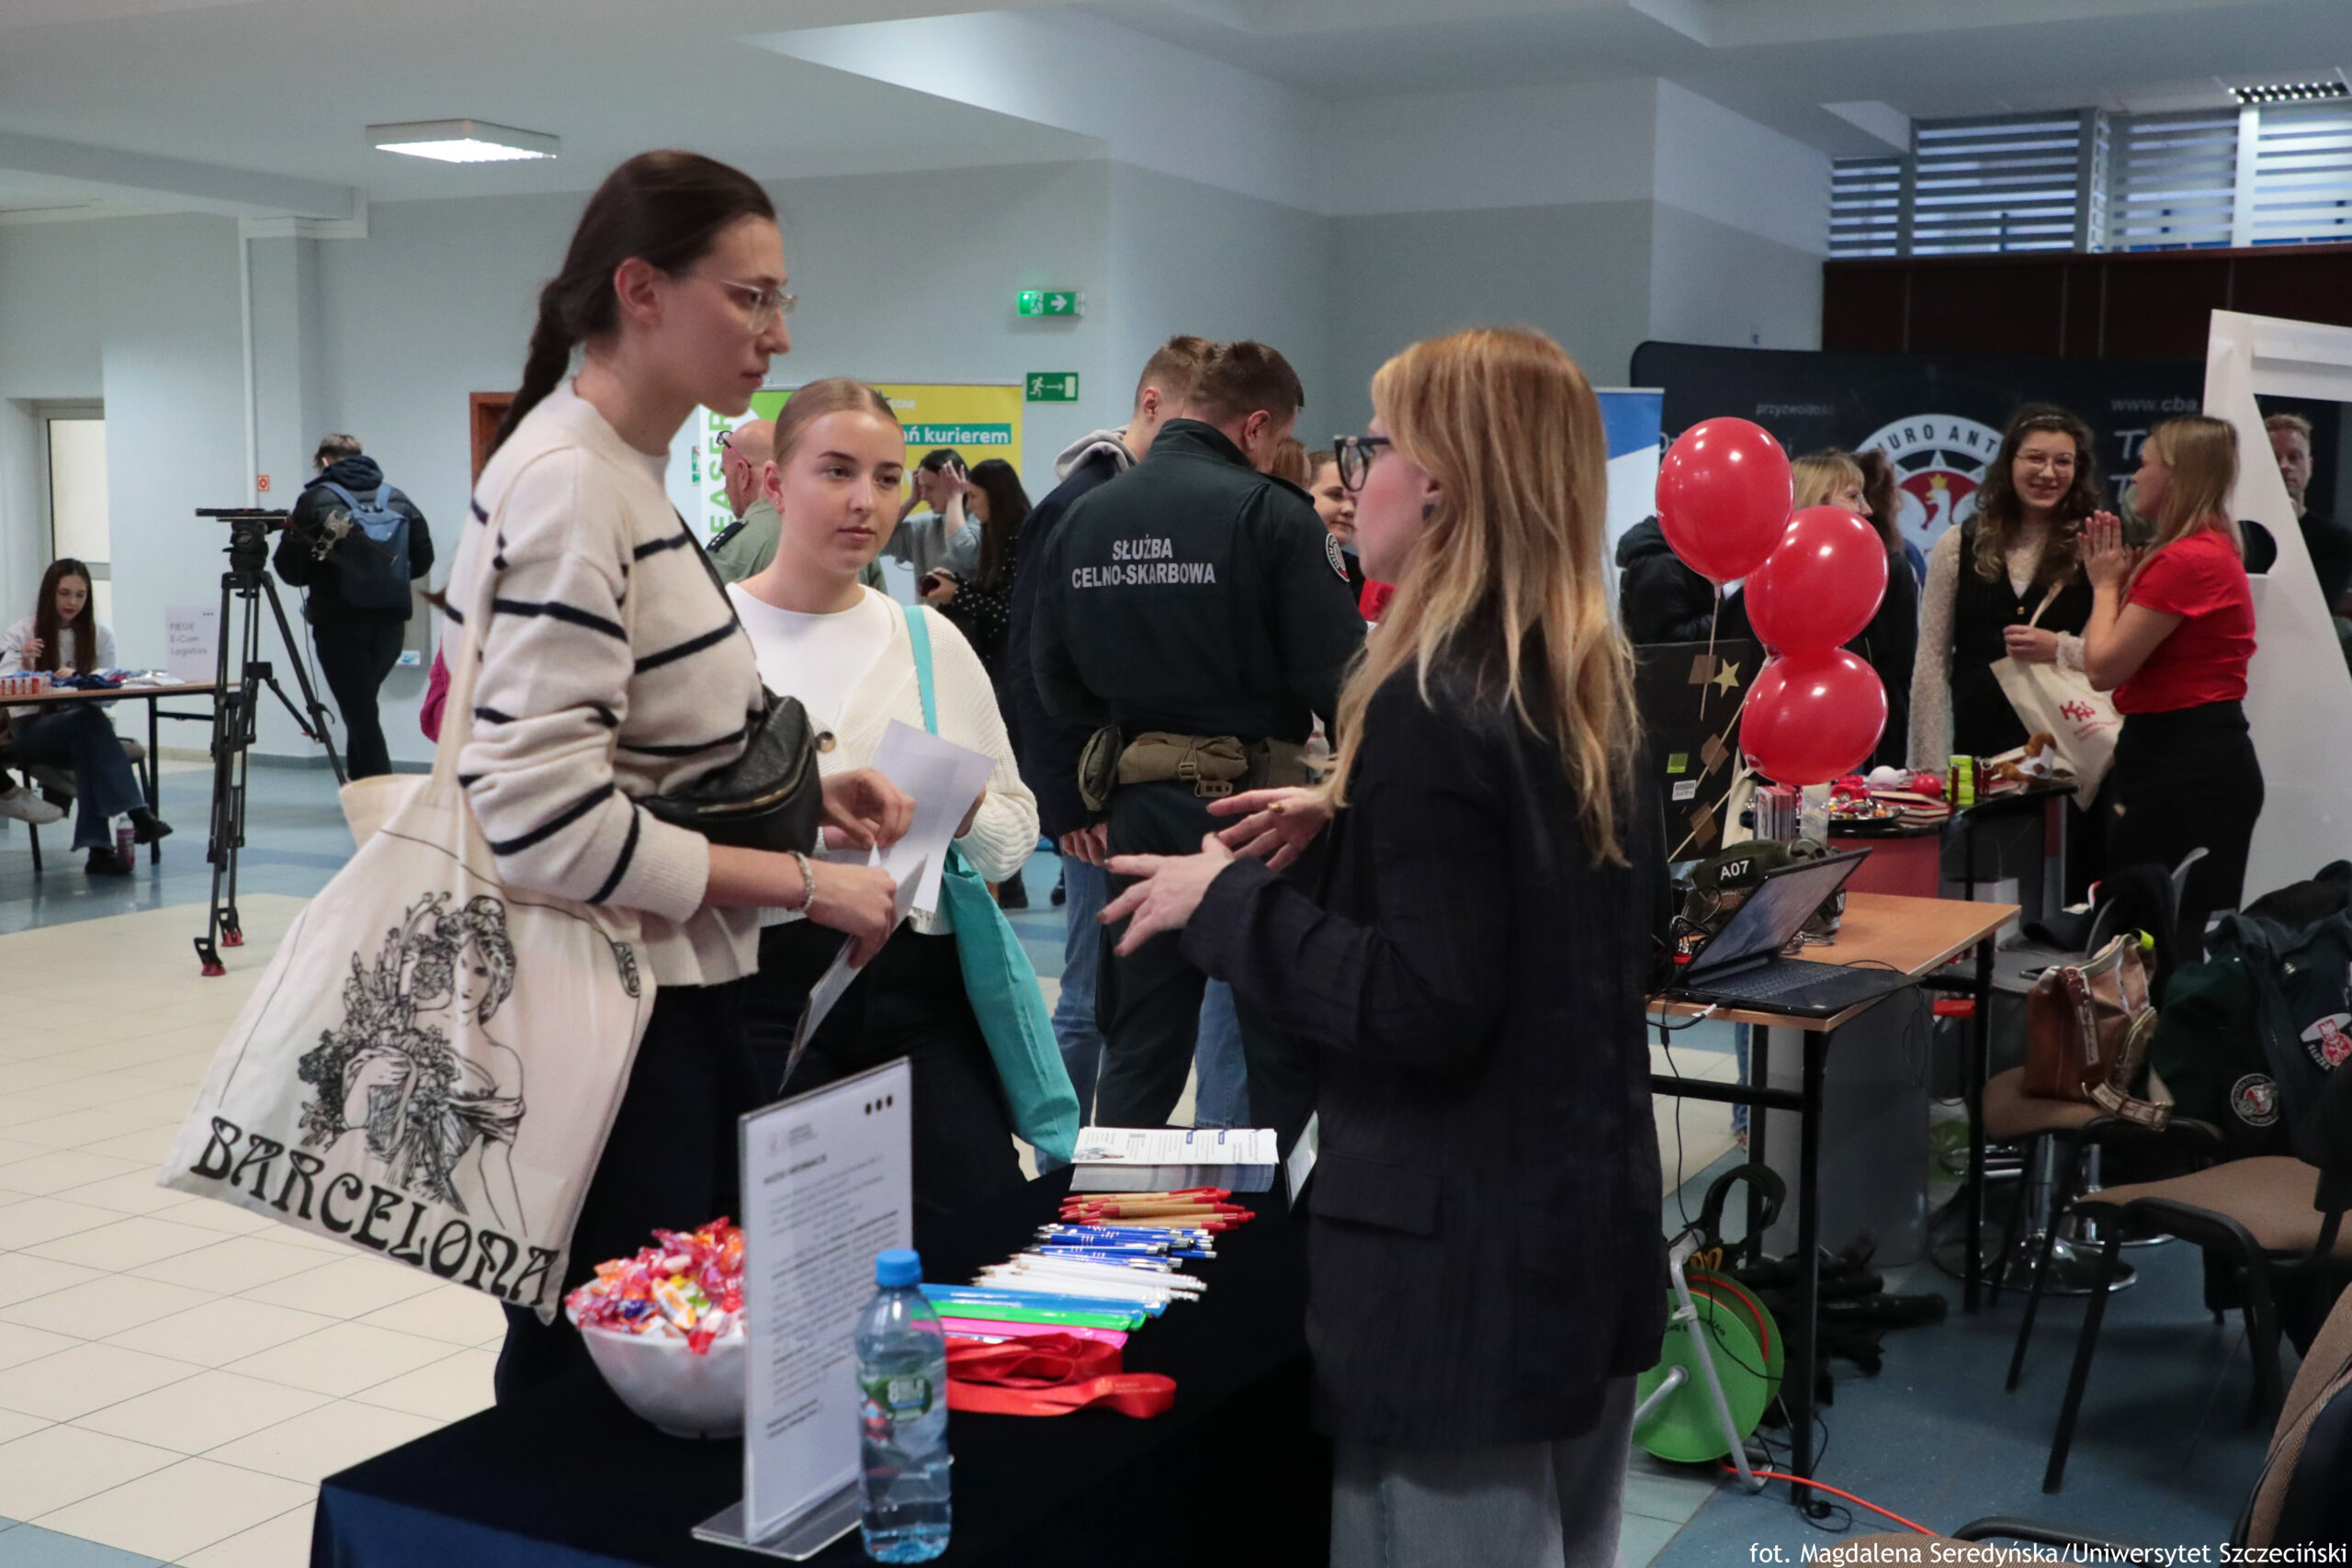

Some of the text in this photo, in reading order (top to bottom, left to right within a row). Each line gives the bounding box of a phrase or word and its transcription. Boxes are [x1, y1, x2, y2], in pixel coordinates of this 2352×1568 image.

[924, 426, 1009, 444] kurierem
[1112, 534, 1173, 560] SŁUŻBA
[1071, 562, 1216, 589] CELNO-SKARBOWA
[1719, 859, 1750, 882] A07
[189, 1115, 560, 1307] BARCELONA
